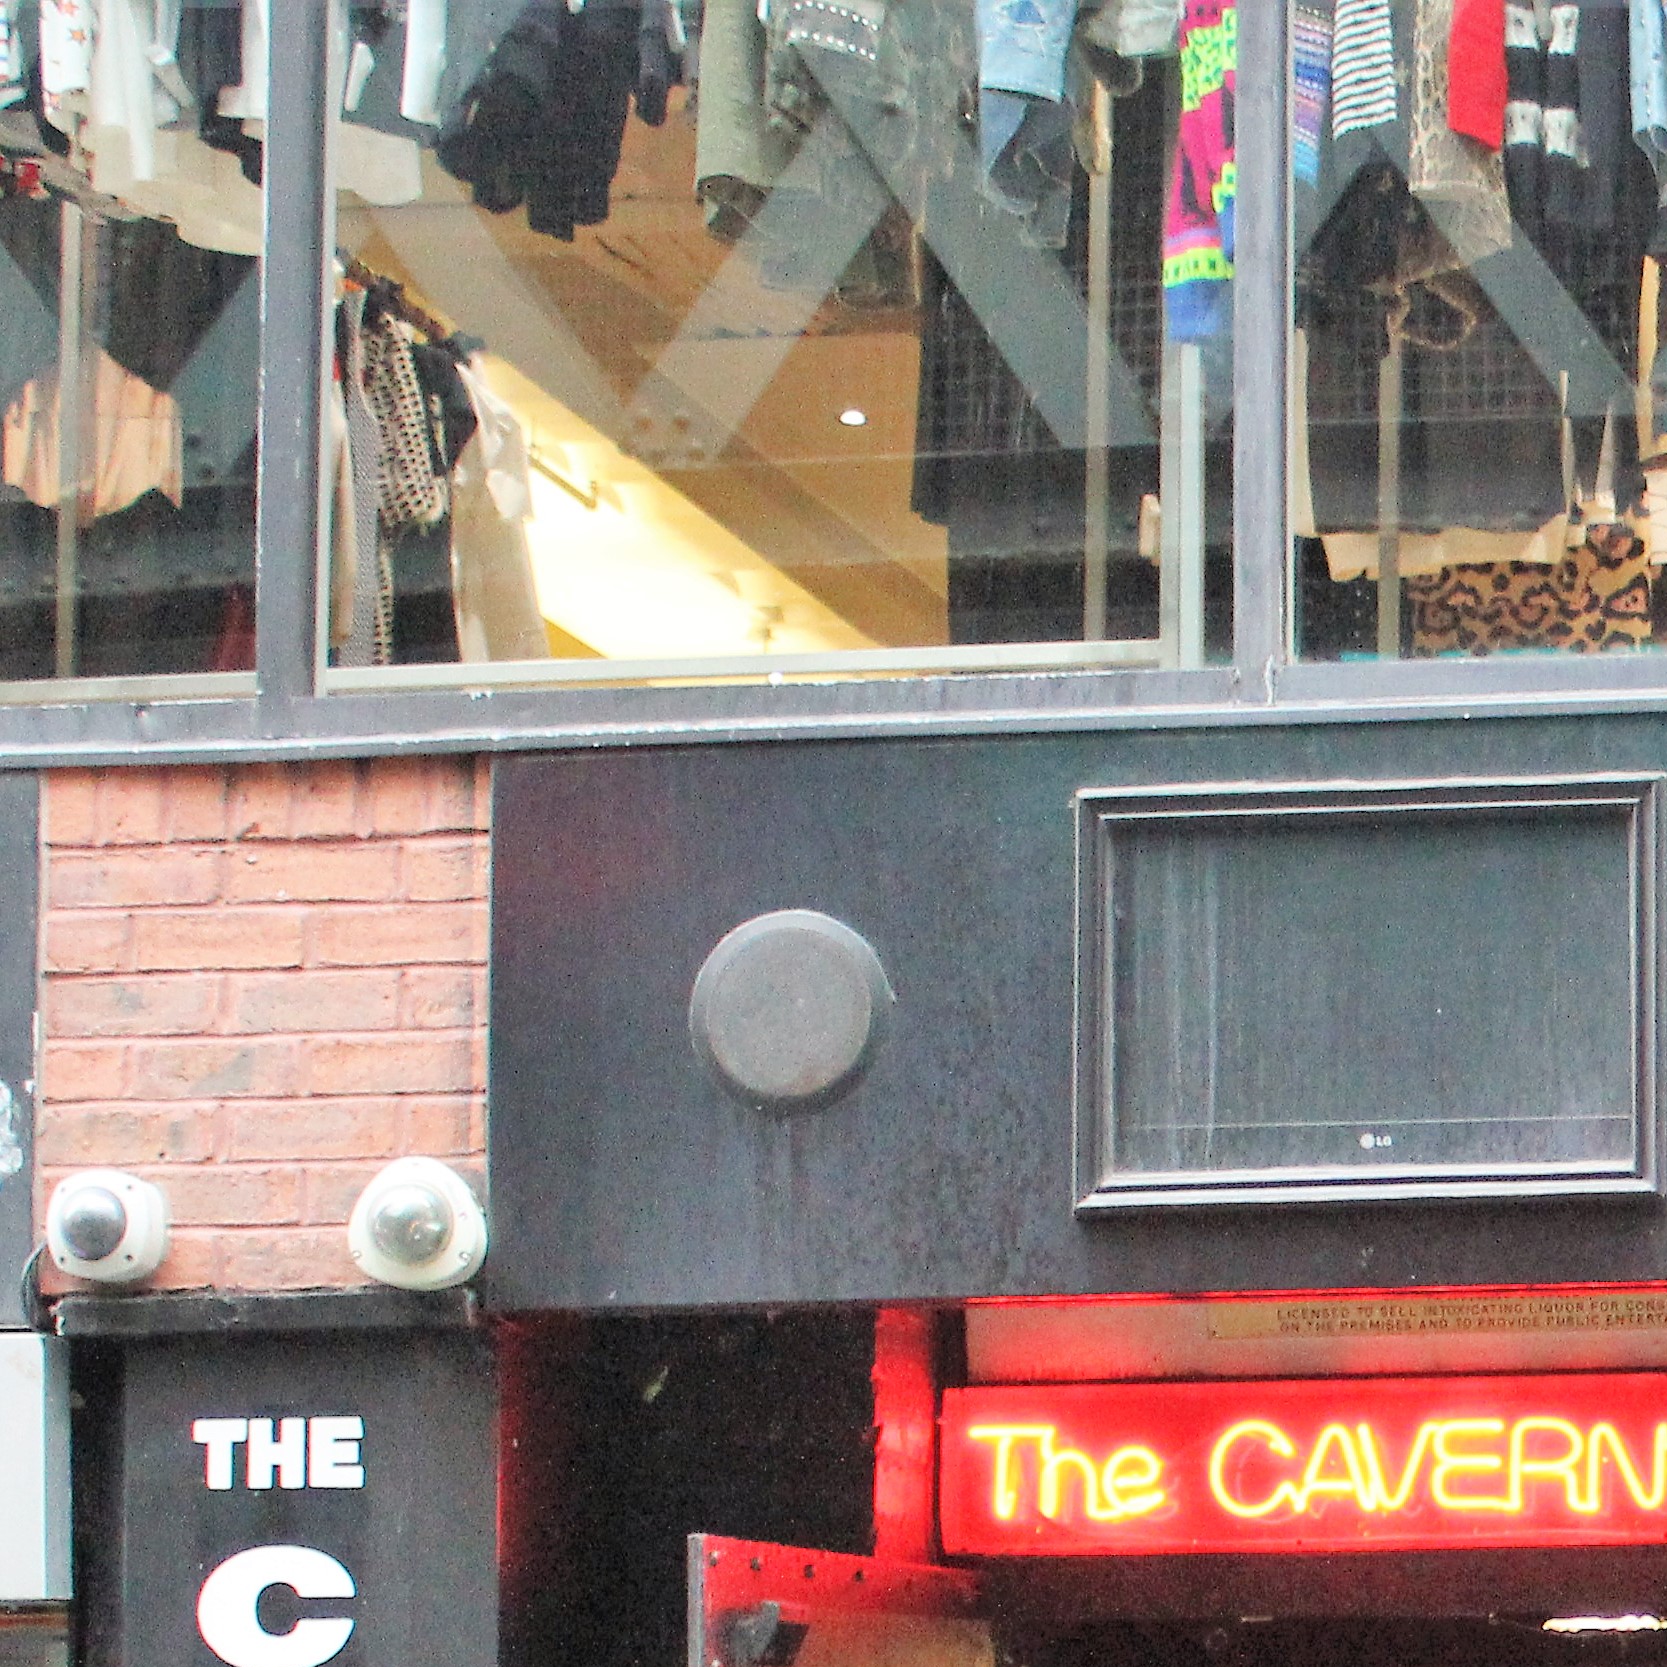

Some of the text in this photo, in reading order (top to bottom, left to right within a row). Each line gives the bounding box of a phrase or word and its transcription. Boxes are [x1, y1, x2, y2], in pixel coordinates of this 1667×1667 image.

[1277, 1307, 1349, 1320] LICENSED
[1357, 1306, 1373, 1318] TO
[1380, 1304, 1416, 1317] SELL
[1423, 1302, 1522, 1317] INTOXICATING
[1529, 1301, 1585, 1313] LIQUOR
[1591, 1301, 1619, 1312] FOR
[1280, 1322, 1300, 1333] ON
[1308, 1321, 1337, 1332] THE
[1340, 1319, 1412, 1332] PREMISES
[1420, 1319, 1448, 1330] AND
[1456, 1318, 1472, 1329] TO
[1478, 1316, 1538, 1329] PROVIDE
[1546, 1315, 1599, 1328] PUBLIC
[191, 1416, 366, 1490] THE
[967, 1423, 1167, 1521] The
